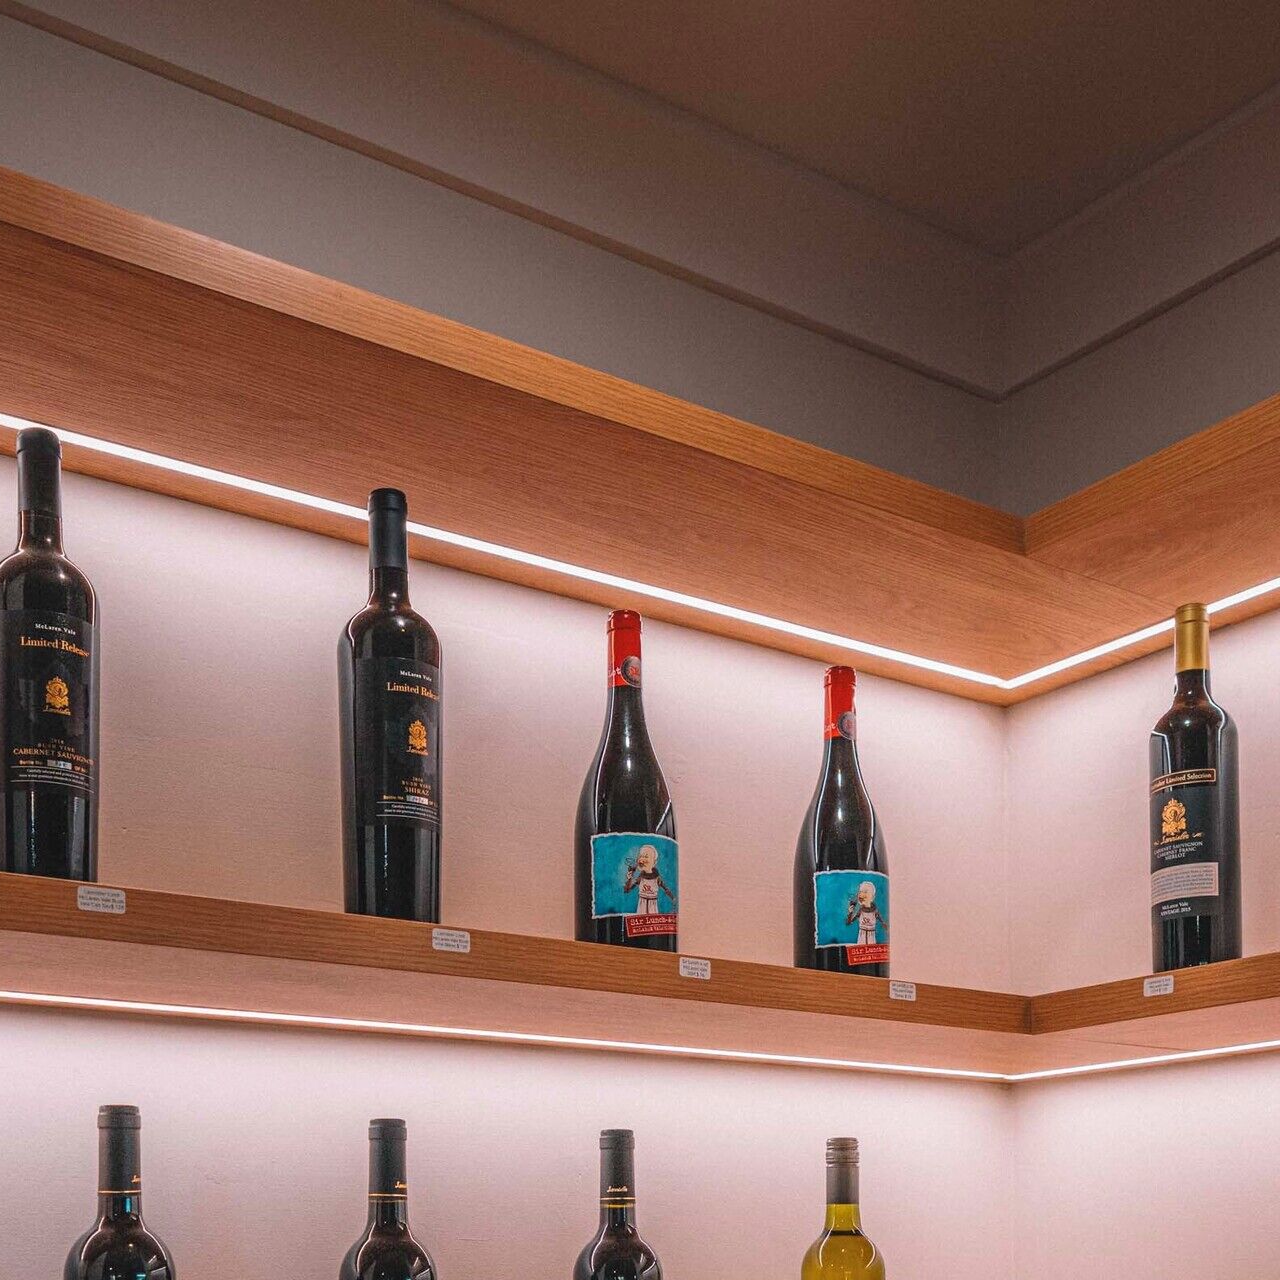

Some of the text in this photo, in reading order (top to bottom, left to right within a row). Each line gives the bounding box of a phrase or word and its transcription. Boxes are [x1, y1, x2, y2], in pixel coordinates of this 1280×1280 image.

[21, 636, 59, 650] Limited
[387, 682, 420, 695] Limited
[13, 748, 55, 756] CABERNET
[404, 787, 429, 796] SHIRAZ
[630, 917, 643, 926] Sir
